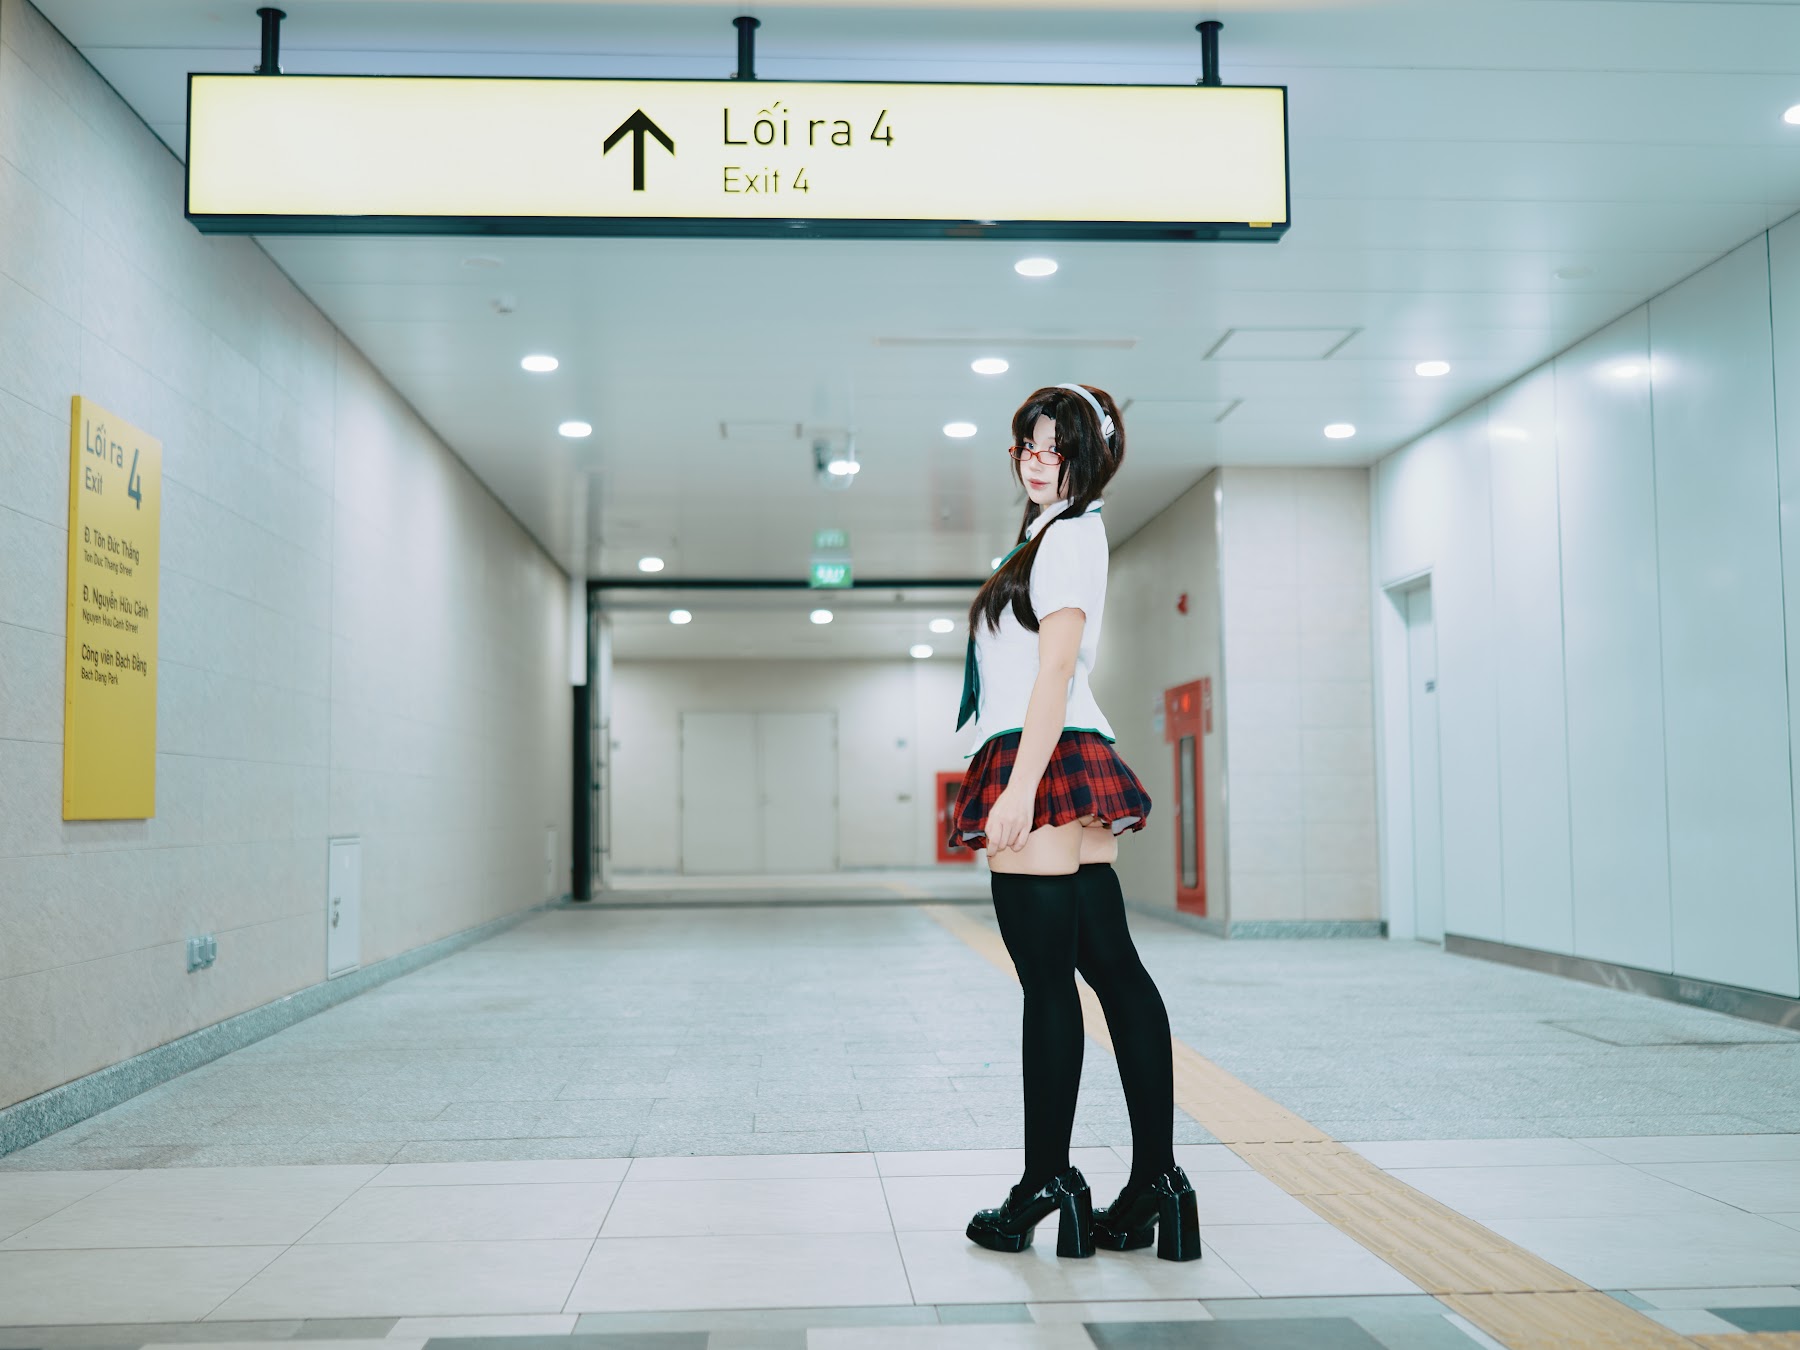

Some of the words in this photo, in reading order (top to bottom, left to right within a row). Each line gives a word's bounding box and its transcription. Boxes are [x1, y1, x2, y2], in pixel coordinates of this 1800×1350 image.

[723, 101, 788, 146] Lối
[808, 119, 852, 146] ra
[870, 109, 894, 147] 4
[723, 166, 780, 193] Exit
[793, 167, 809, 193] 4
[86, 419, 107, 460] Lối
[110, 441, 123, 468] ra
[127, 448, 142, 511] 4
[85, 466, 103, 495] Exit
[84, 526, 92, 545] Đ.
[94, 529, 106, 550] Tôn
[107, 535, 121, 555] Đức
[121, 540, 140, 566] Thắng
[119, 562, 132, 577] Street
[83, 584, 91, 603] Đ.
[125, 620, 139, 634] Street
[81, 643, 99, 667] Công
[100, 648, 114, 667] viên
[115, 650, 131, 672] Bạch
[131, 652, 147, 677] Đằng
[81, 667, 94, 681] Bach
[107, 672, 119, 686] Park
